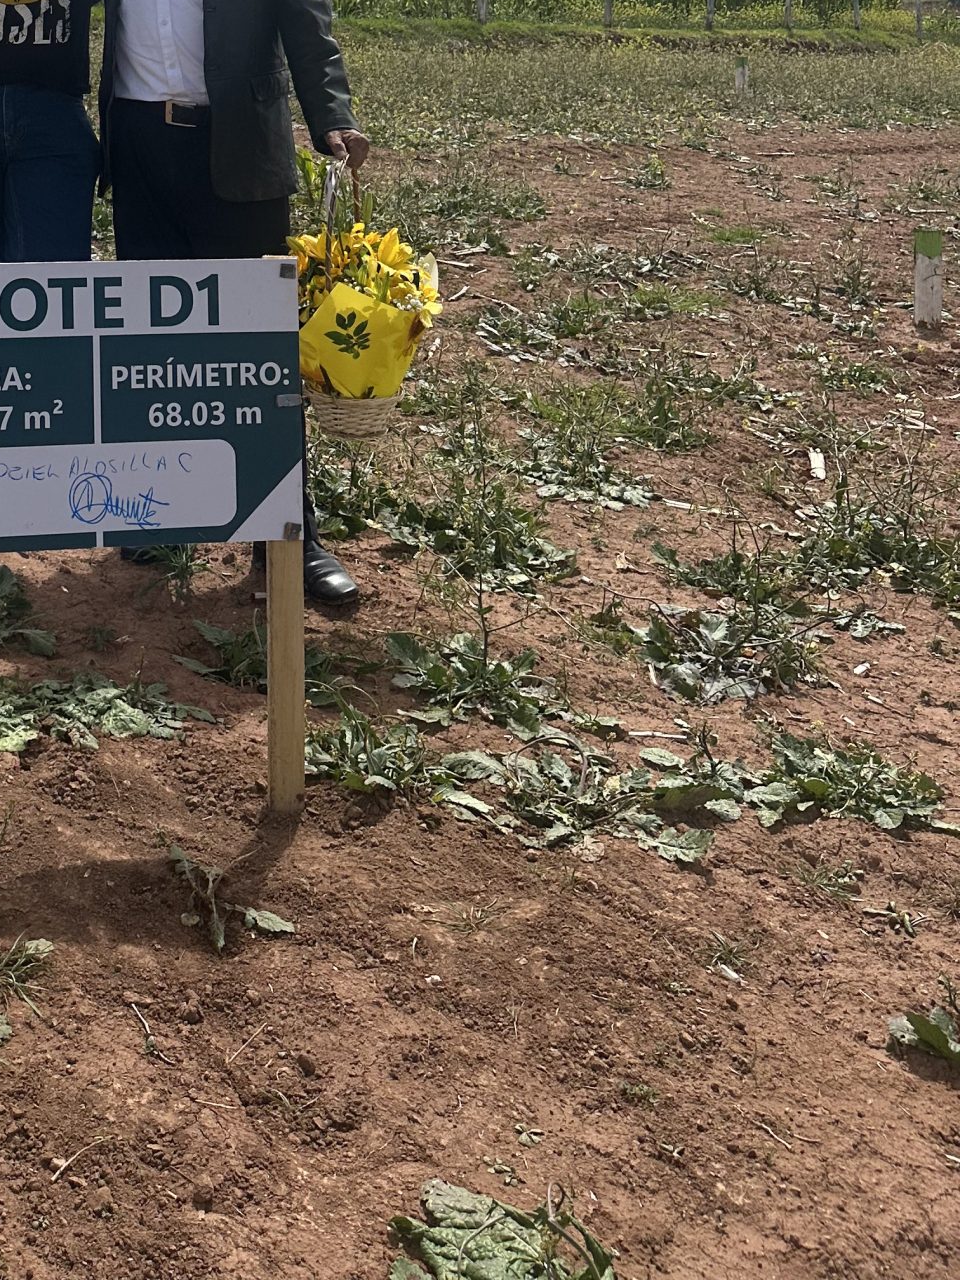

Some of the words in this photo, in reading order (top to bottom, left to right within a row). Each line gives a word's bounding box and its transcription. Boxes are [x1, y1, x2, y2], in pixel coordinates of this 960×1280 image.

[149, 273, 221, 328] D1
[110, 356, 291, 391] PERÍMETRO:
[24, 399, 65, 431] m²
[147, 401, 227, 428] 68.03
[235, 404, 263, 426] m
[178, 452, 194, 474] C
